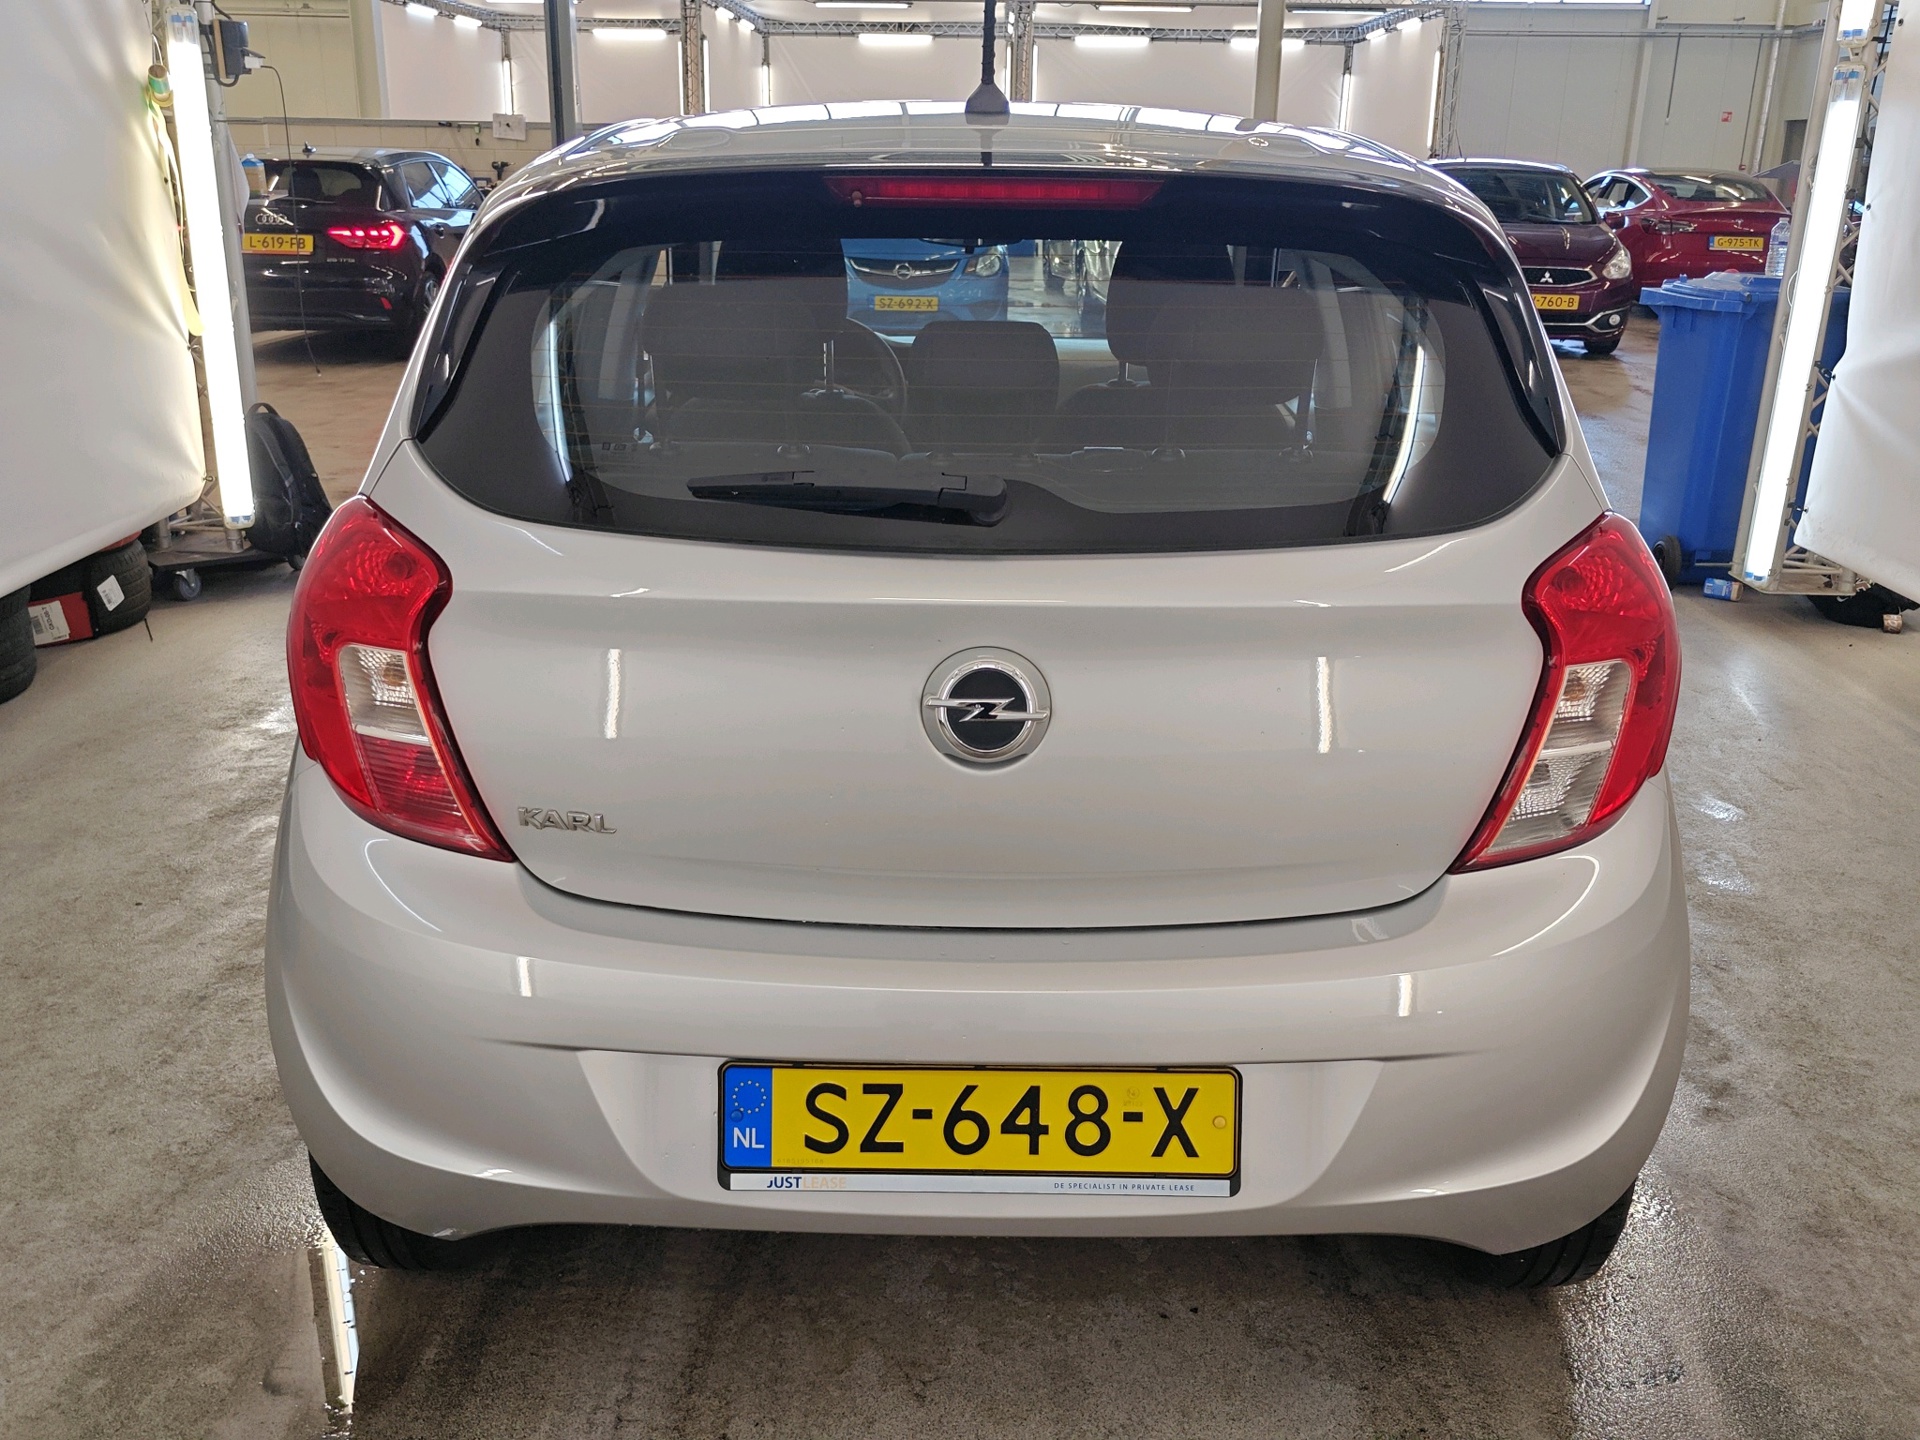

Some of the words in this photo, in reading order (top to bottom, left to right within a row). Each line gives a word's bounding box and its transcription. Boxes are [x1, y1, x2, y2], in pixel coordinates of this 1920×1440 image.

[1717, 238, 1760, 247] G-975-TK
[879, 297, 934, 309] SZ-692-X
[518, 806, 617, 834] KARL
[803, 1082, 1200, 1158] SZ-648-X
[733, 1127, 765, 1149] NL
[1054, 1182, 1065, 1190] DE
[1068, 1182, 1116, 1191] SPECIALIST
[1119, 1183, 1129, 1191] IN
[1132, 1183, 1166, 1192] PRIVATE
[1169, 1184, 1195, 1193] LEASE
